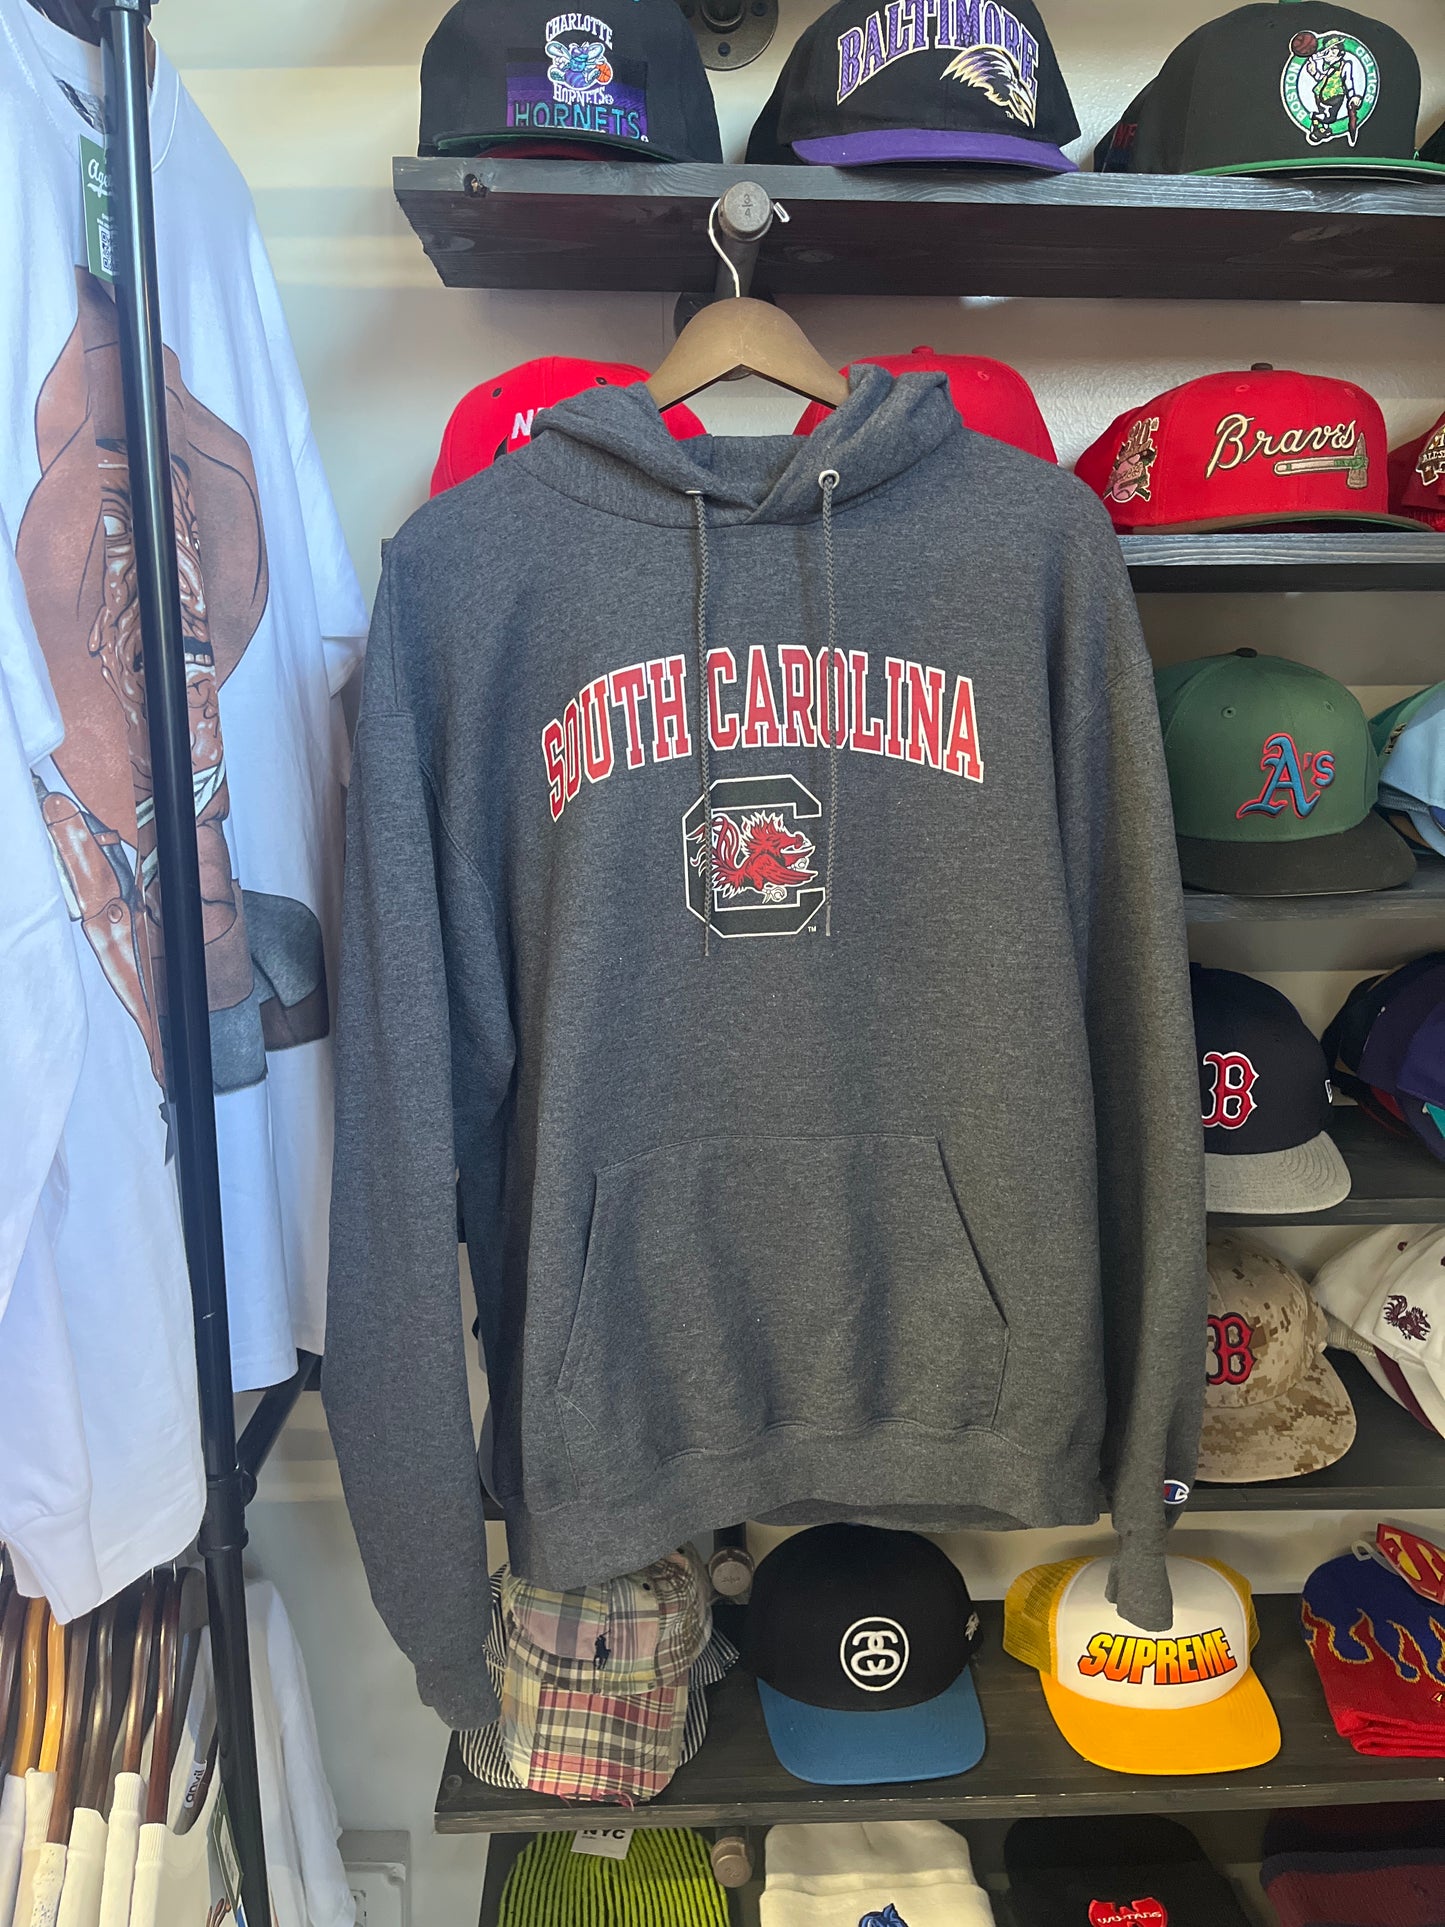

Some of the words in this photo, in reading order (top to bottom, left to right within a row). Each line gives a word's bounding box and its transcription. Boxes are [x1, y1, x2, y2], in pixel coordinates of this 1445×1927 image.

[545, 12, 613, 51] CHARLOTTE
[837, 0, 1039, 106] BALTIMORE
[552, 81, 607, 107] HORNETS
[1284, 61, 1308, 121] BOSTON
[1355, 46, 1378, 104] CELTICS
[513, 101, 641, 141] HORNETS
[1204, 412, 1357, 480] Braves
[541, 653, 693, 823] SOUTH
[706, 644, 985, 783] CAROLINA
[1235, 732, 1337, 820] A's
[1201, 1050, 1260, 1131] B
[1205, 1311, 1258, 1386] B
[1077, 1627, 1238, 1686] SUPREME
[185, 1769, 205, 1803] anvil
